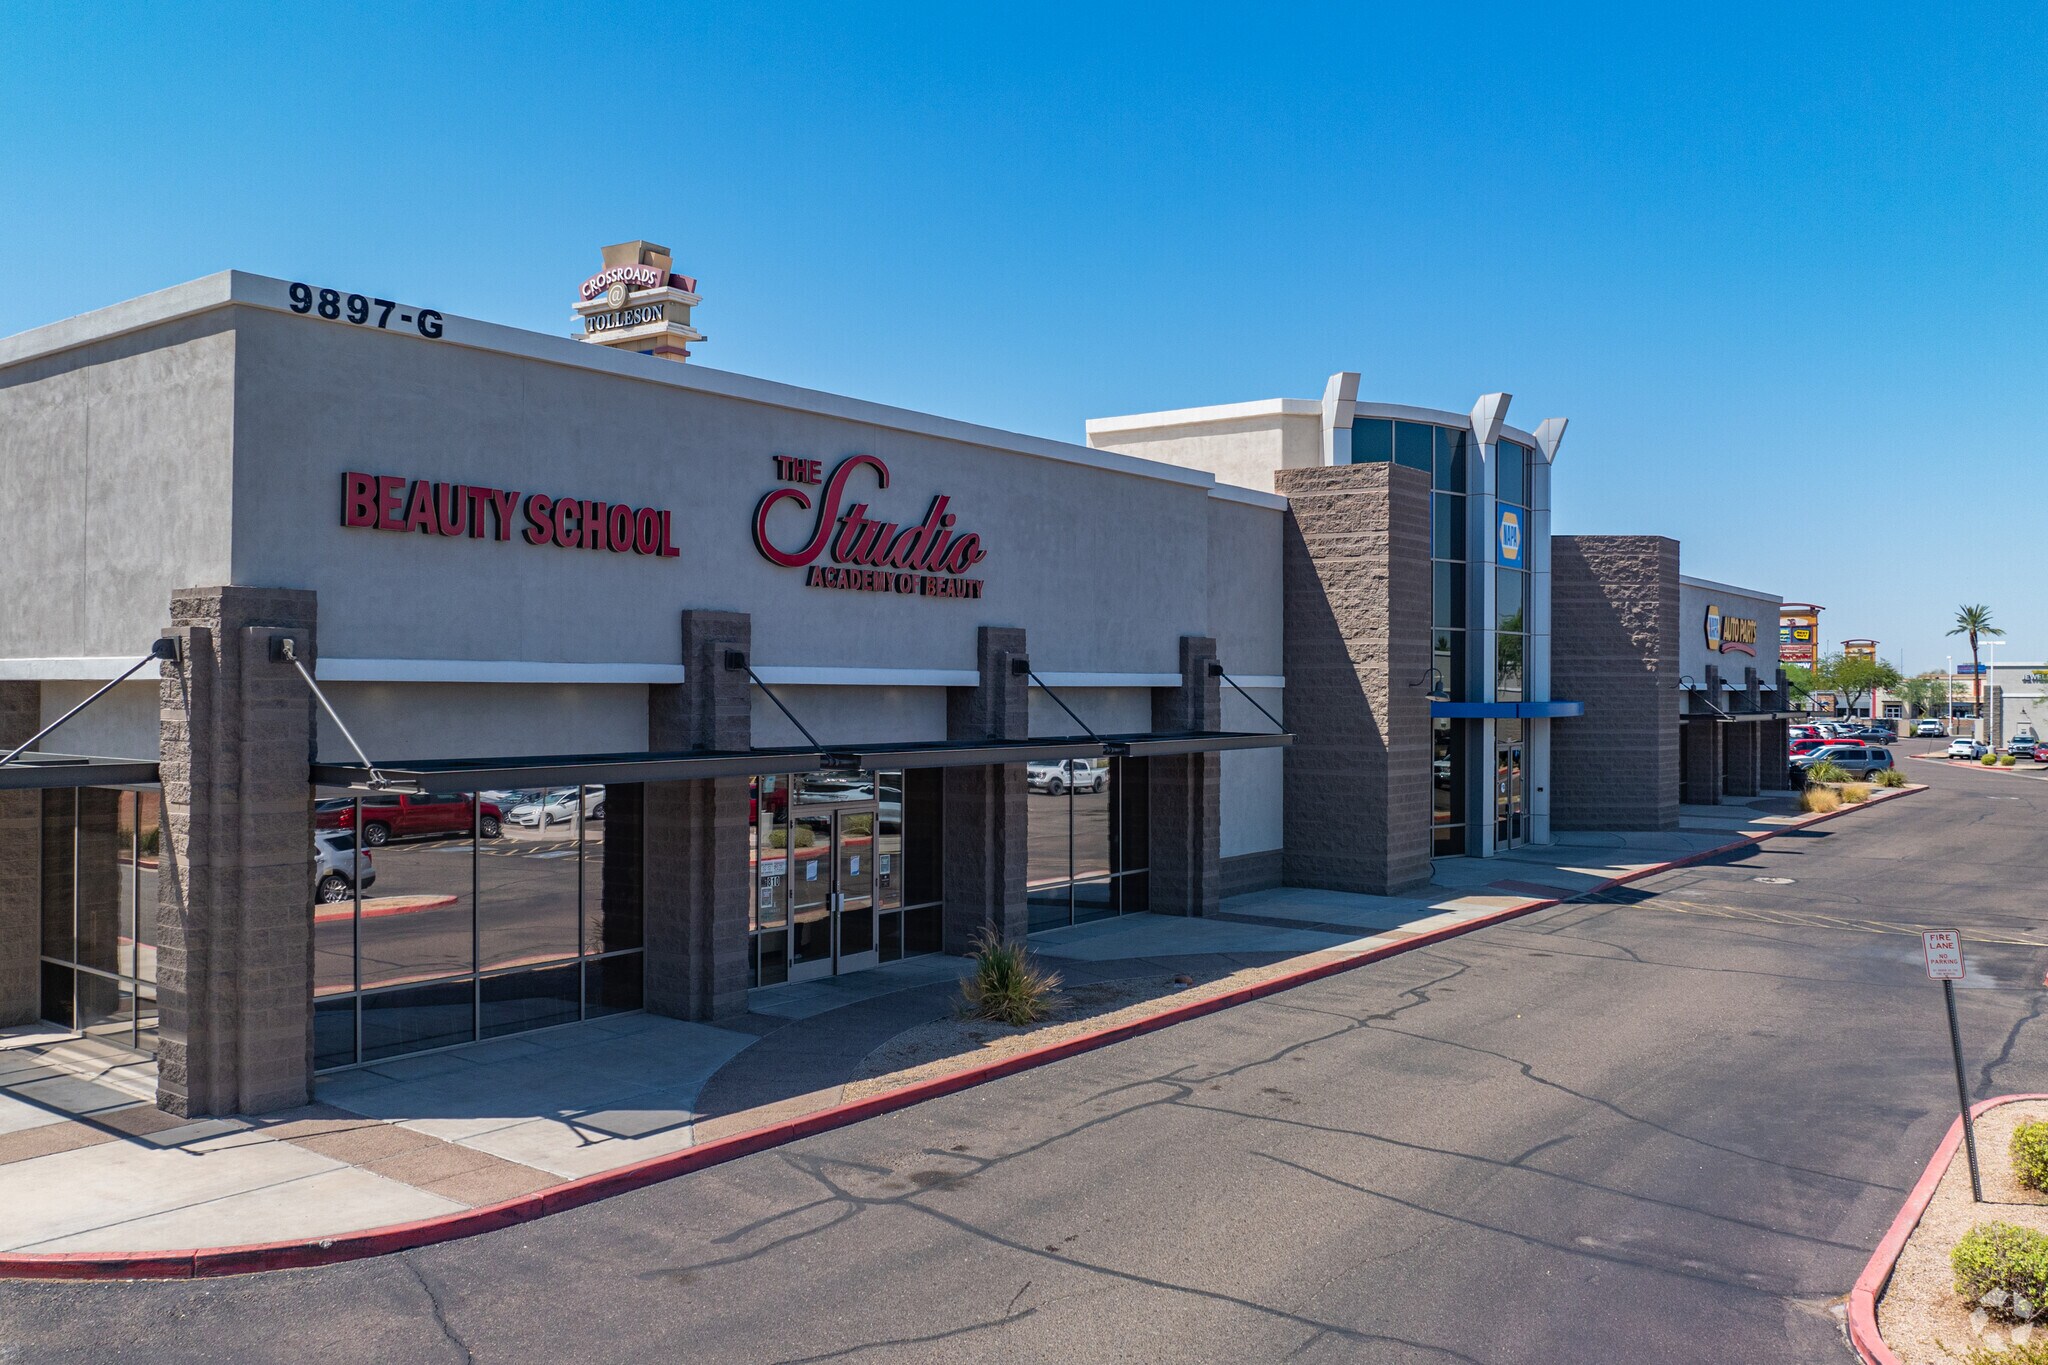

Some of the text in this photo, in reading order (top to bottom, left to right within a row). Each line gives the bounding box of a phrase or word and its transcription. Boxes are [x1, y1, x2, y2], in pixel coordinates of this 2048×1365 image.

[582, 266, 656, 297] CROSSROADS
[288, 281, 443, 339] 9897-G
[587, 304, 664, 332] TOLLESON
[772, 455, 823, 486] THE
[340, 471, 681, 558] BEAUTY SCHOOL
[751, 455, 987, 575] Studio
[806, 565, 985, 599] ACADEMY OF BEAUTY
[1722, 616, 1757, 644] AUTO PARTS
